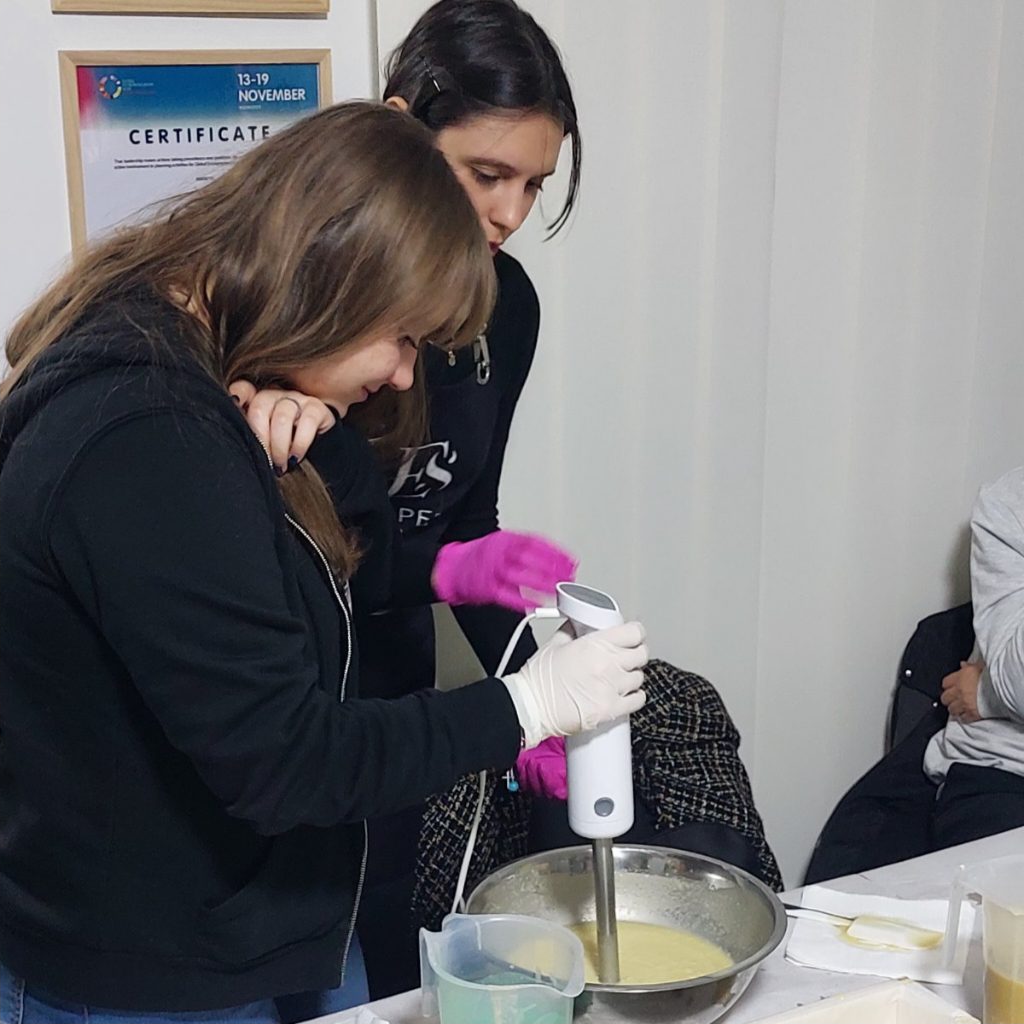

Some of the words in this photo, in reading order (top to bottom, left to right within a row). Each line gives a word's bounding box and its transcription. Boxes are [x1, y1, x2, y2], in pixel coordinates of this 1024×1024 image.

[237, 73, 269, 86] 13-19
[238, 88, 306, 102] NOVEMBER
[129, 125, 270, 145] CERTIFICATE
